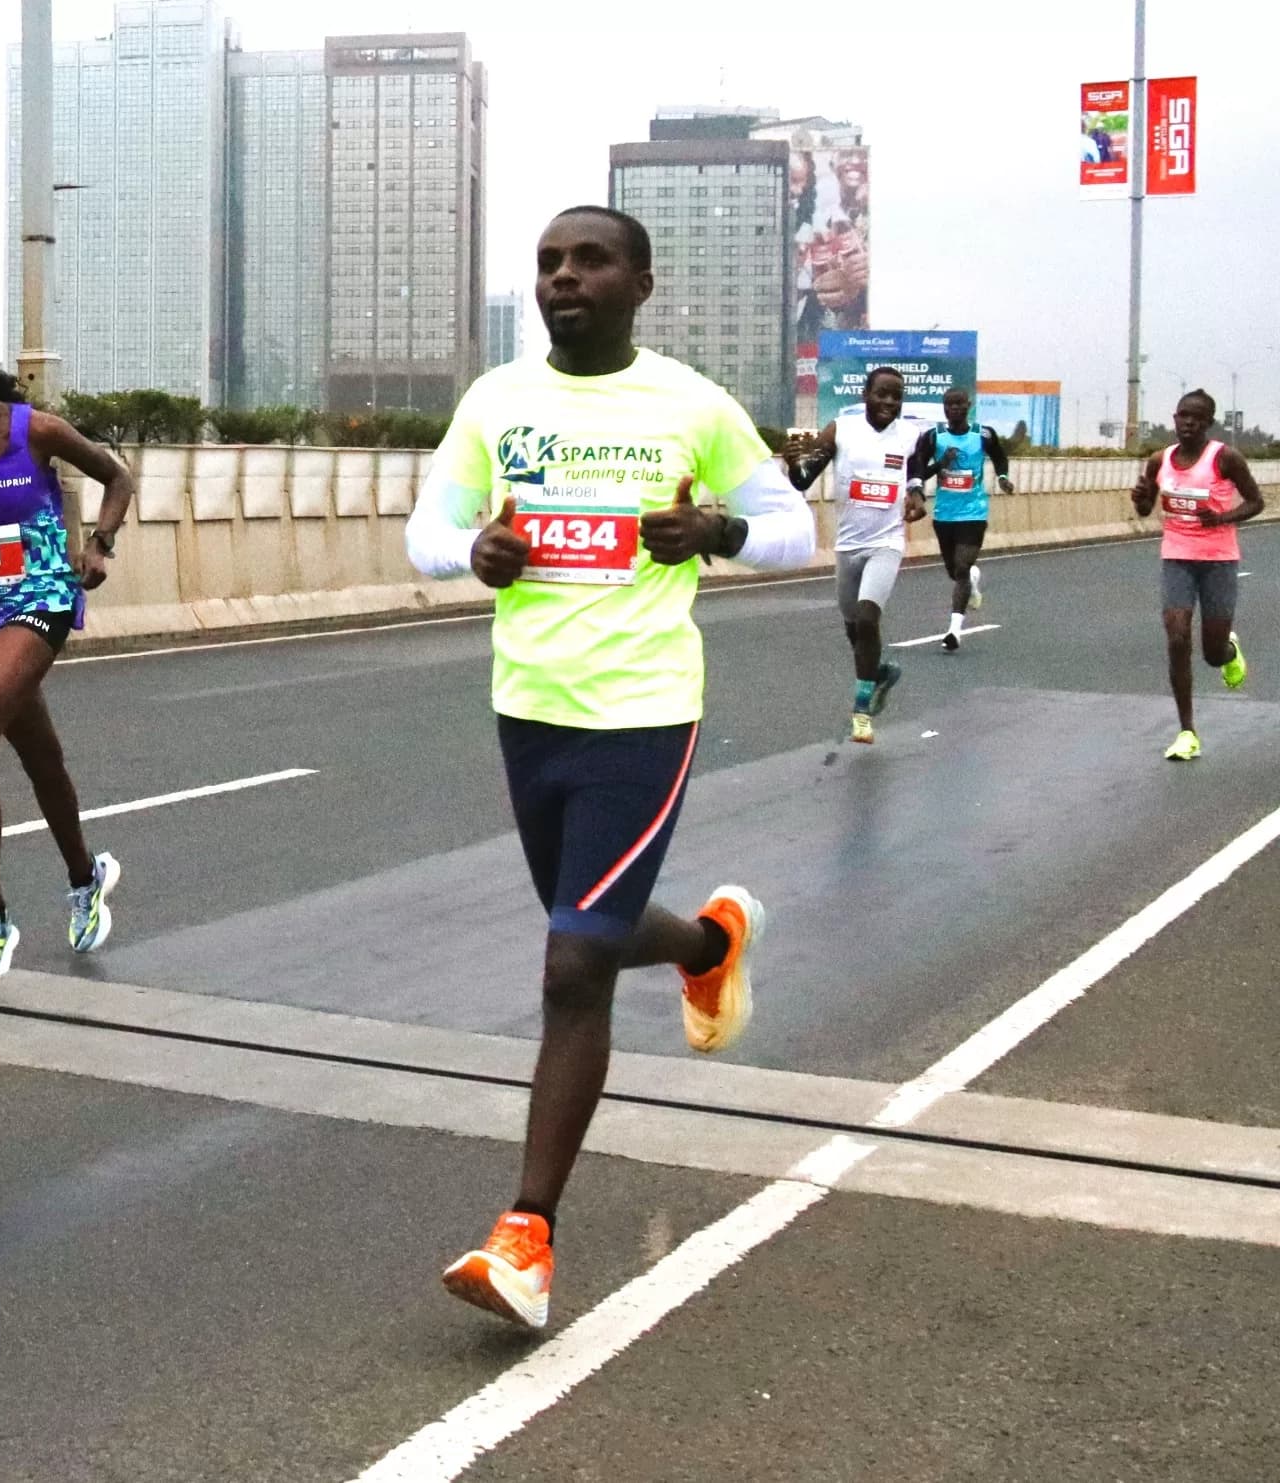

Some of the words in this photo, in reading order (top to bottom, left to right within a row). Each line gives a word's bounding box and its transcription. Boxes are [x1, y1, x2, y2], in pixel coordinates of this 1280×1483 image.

[1167, 97, 1191, 176] SGA
[561, 446, 662, 463] SPARTANS
[565, 468, 626, 483] running
[631, 468, 664, 482] club
[542, 486, 597, 498] NAIROBI
[523, 519, 618, 551] 1434
[11, 614, 50, 632] IPRUN
